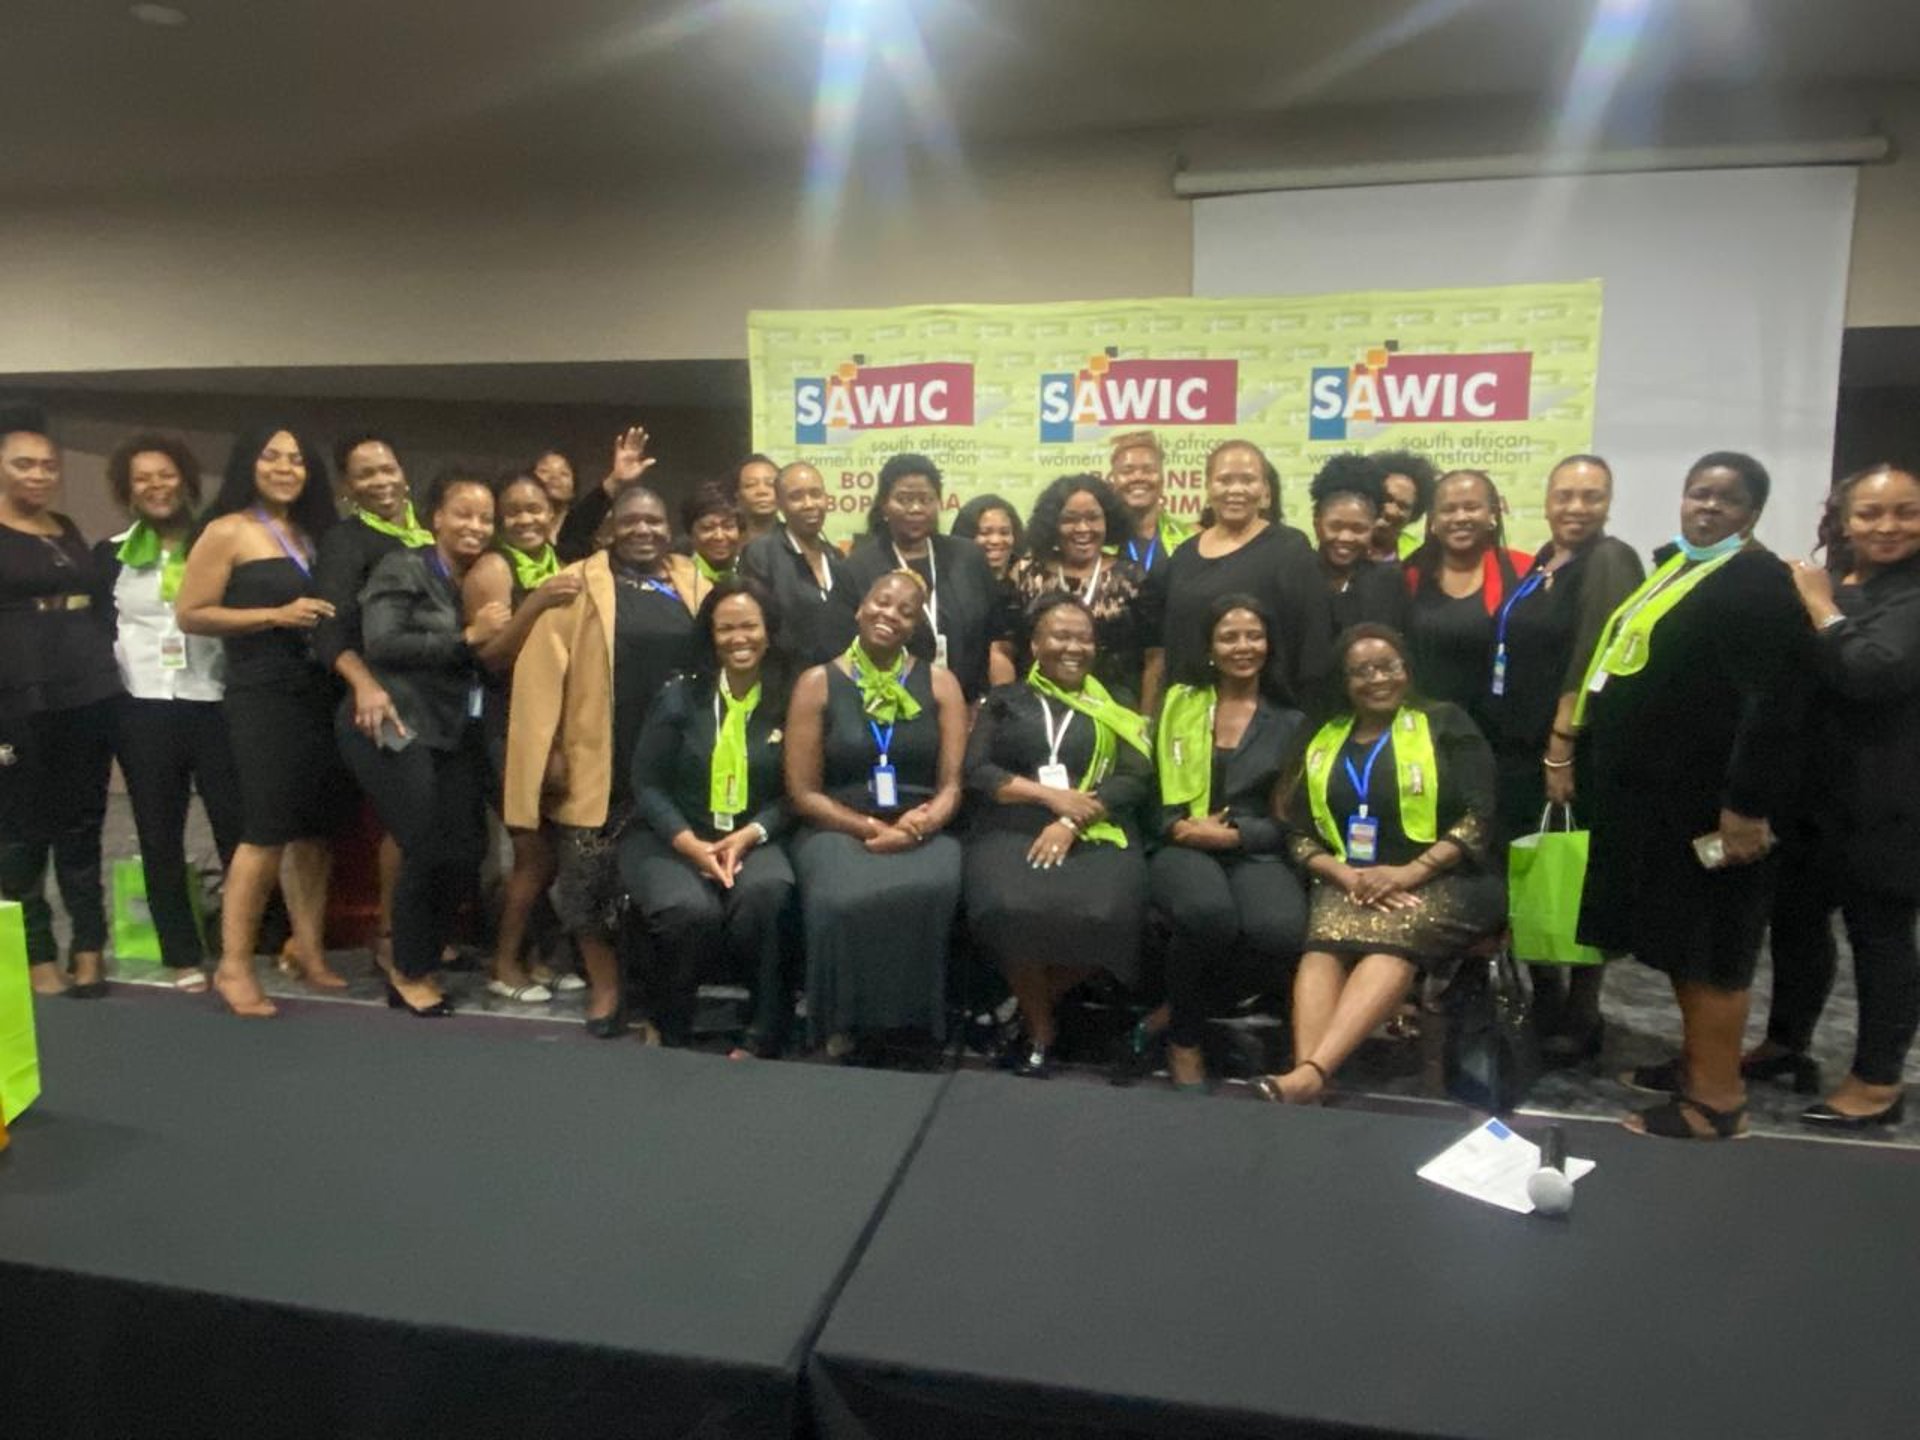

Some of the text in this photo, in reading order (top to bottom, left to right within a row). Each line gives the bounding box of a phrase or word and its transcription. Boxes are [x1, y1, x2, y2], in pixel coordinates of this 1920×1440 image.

[797, 379, 948, 426] SAWIC
[1042, 376, 1209, 423] SAWIC
[1311, 371, 1498, 420] SAWIC
[871, 433, 977, 453] south african
[1175, 431, 1227, 450] afric
[1401, 429, 1530, 449] south african
[860, 455, 874, 467] in
[1039, 452, 1102, 466] women
